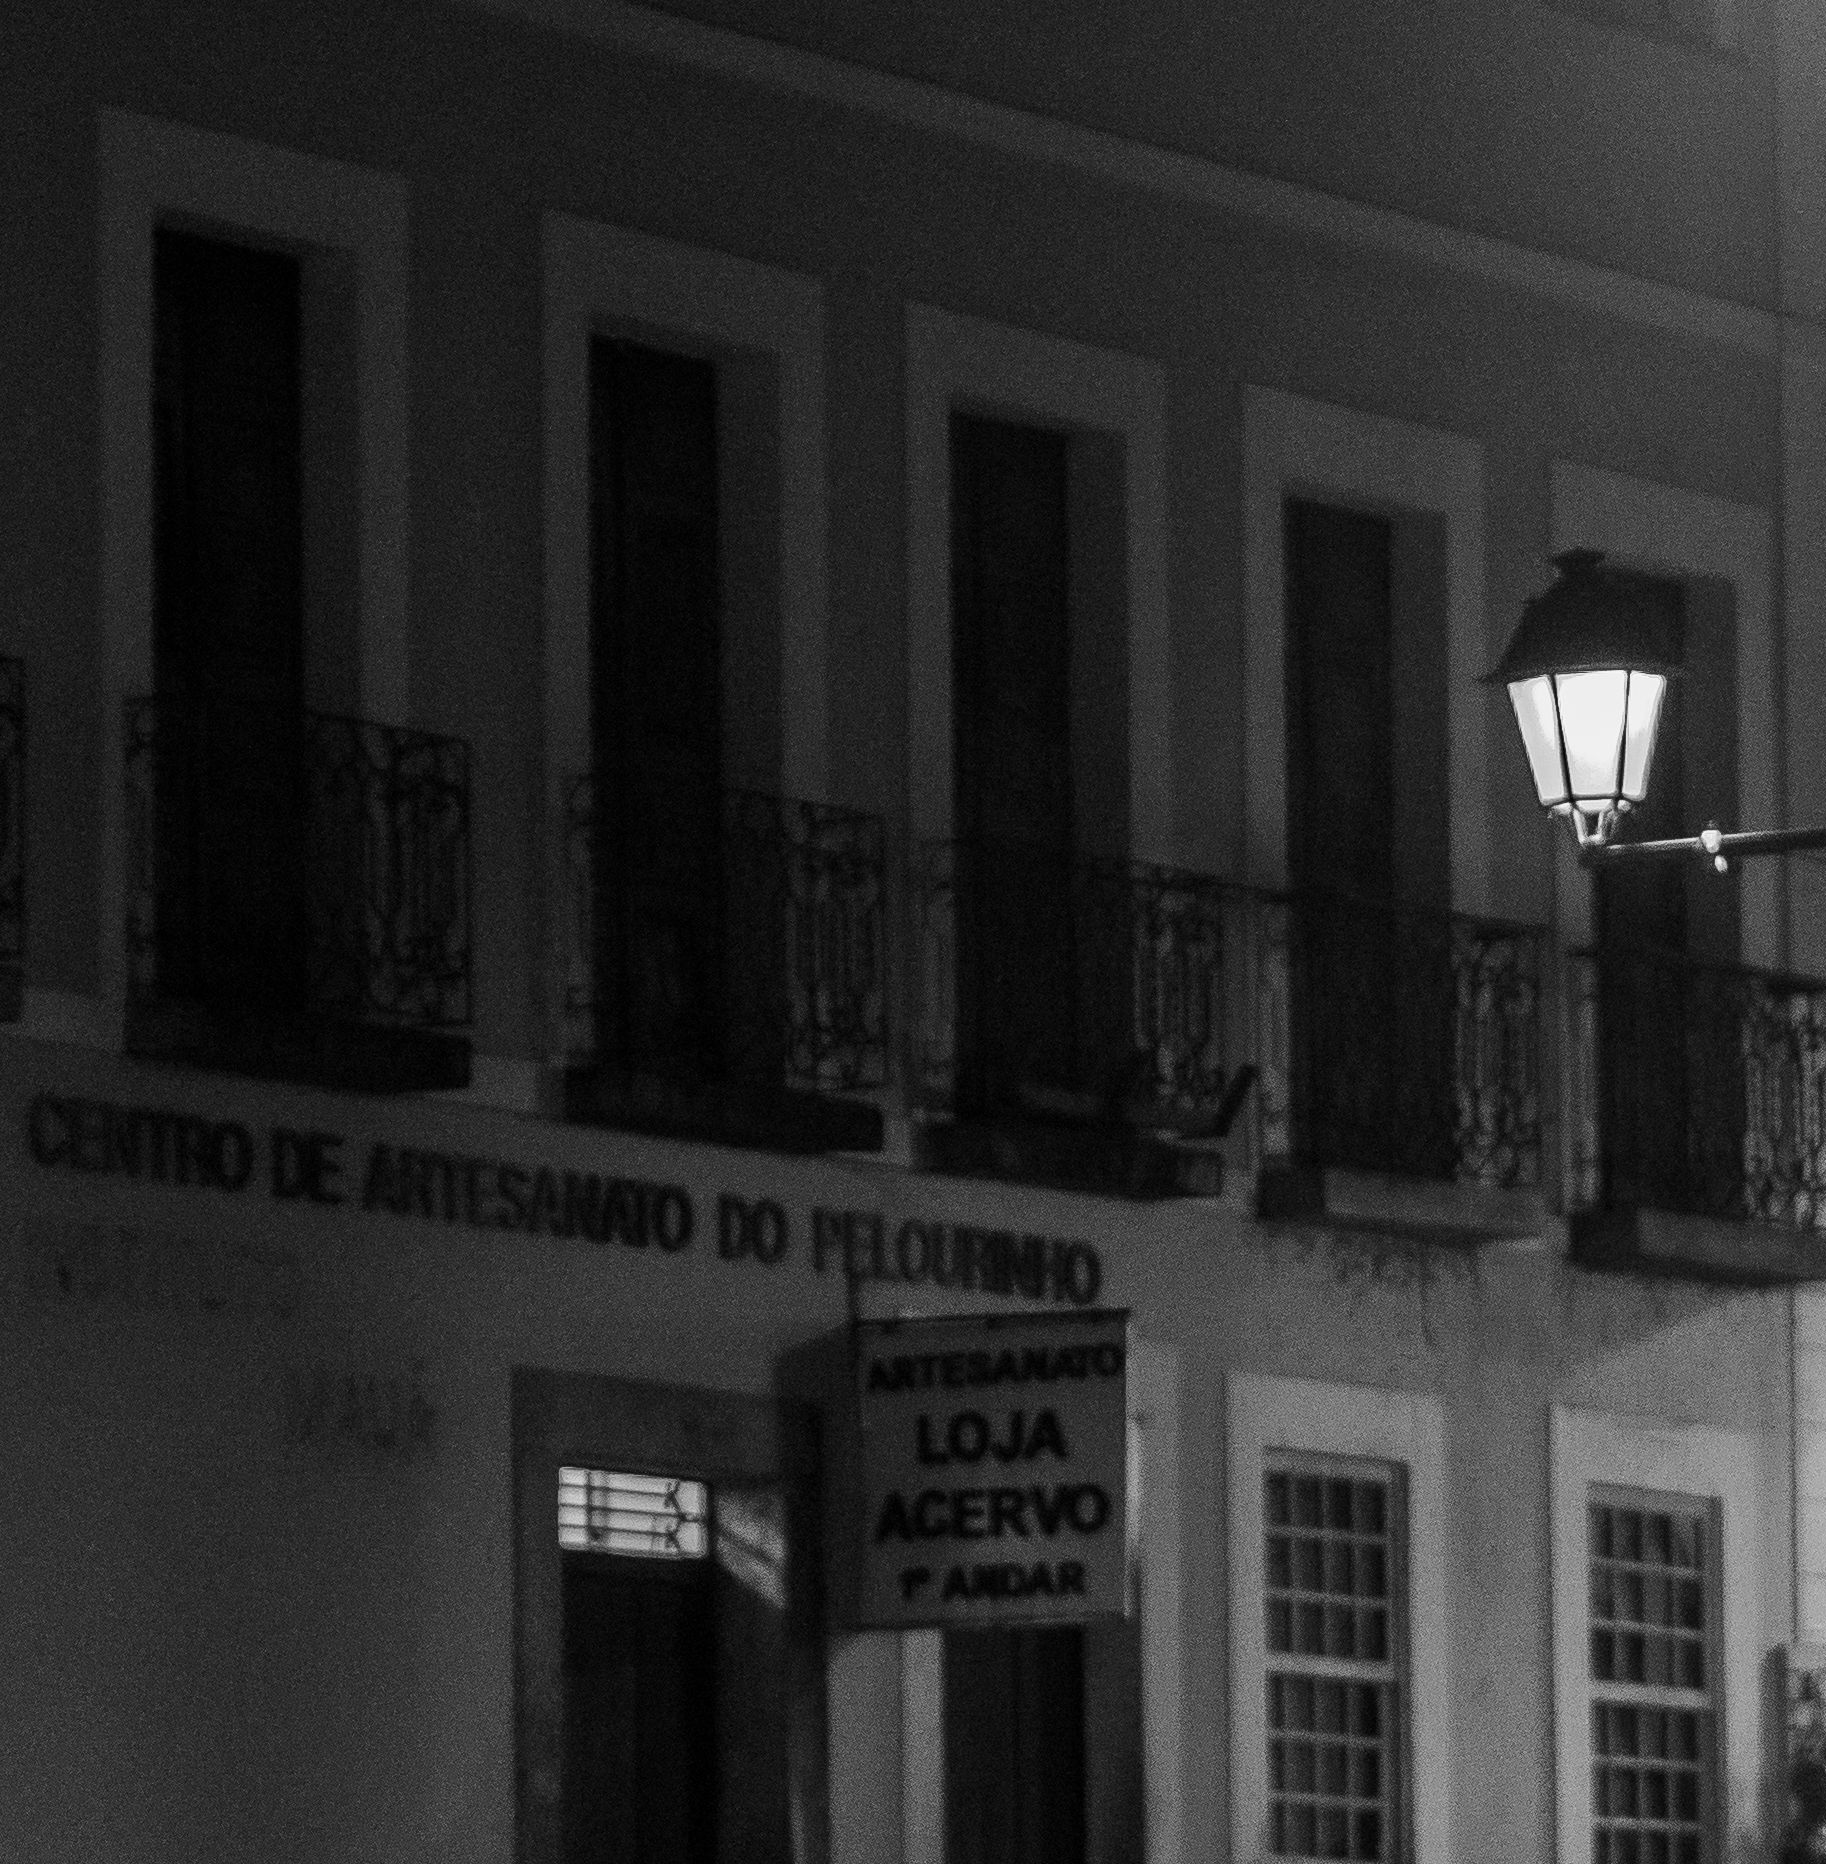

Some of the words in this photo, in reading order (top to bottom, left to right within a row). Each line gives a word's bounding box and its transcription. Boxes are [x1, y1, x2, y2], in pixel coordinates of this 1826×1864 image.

[29, 1092, 254, 1192] CENTRO
[271, 1127, 345, 1205] DE
[363, 1144, 693, 1252] ARTESANATO
[717, 1193, 788, 1264] DO
[813, 1208, 1102, 1303] PELOURINHO
[868, 1344, 1123, 1392] ARTESANATO
[917, 1410, 1068, 1464] LOJA
[876, 1485, 1110, 1542] ACERVO
[943, 1563, 1086, 1601] ANDAR
